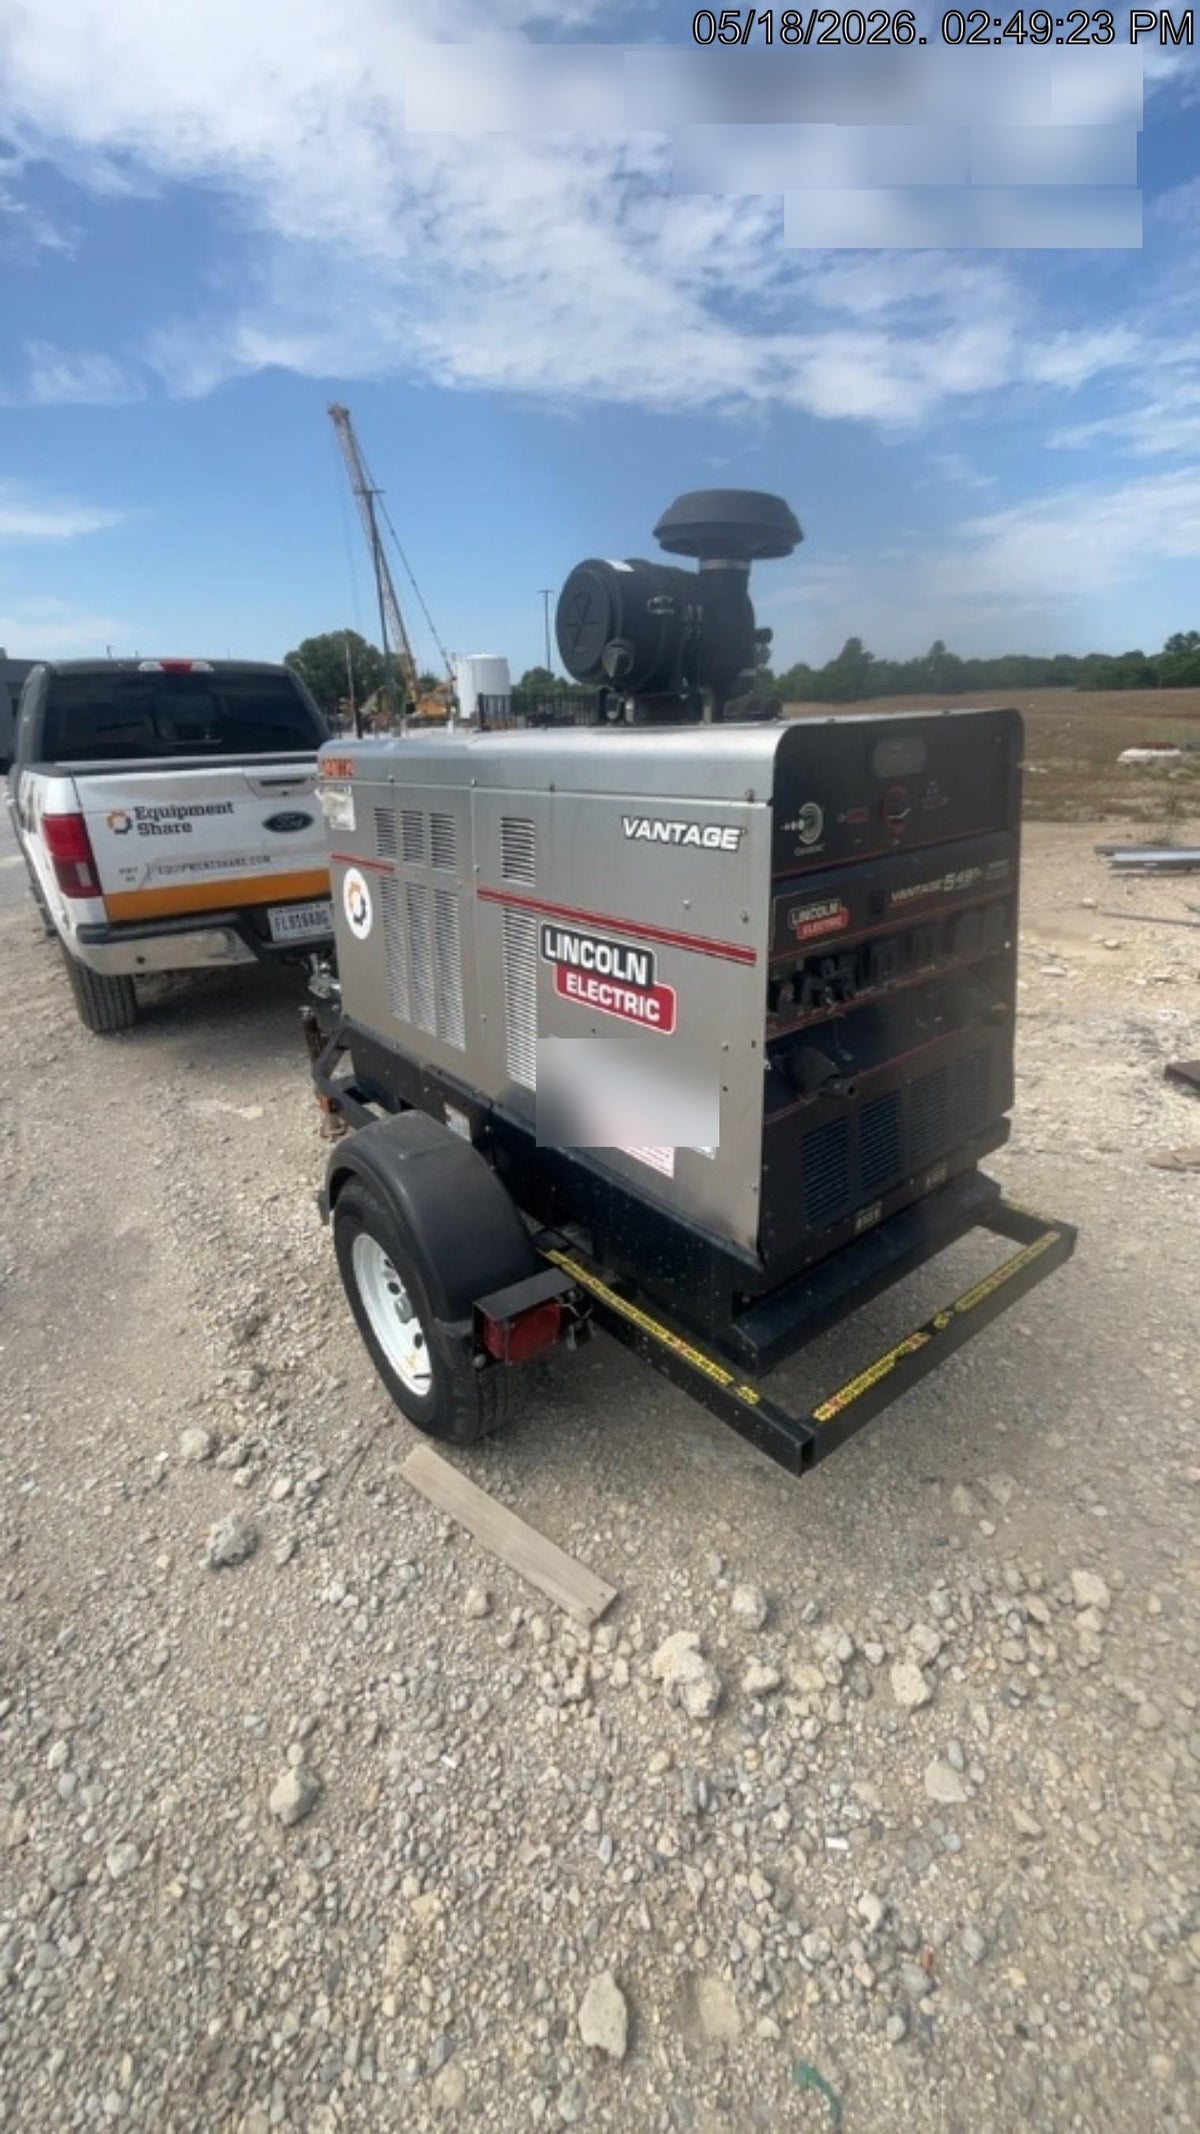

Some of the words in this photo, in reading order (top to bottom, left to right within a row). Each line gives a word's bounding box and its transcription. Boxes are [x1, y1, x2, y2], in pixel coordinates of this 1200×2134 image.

[133, 801, 235, 821] Equipment
[137, 821, 193, 836] Share
[622, 816, 741, 851] VANTAGE
[791, 901, 838, 925] LINCOLN
[544, 928, 648, 986] LINCOLN
[565, 972, 661, 1022] ELECTRIC
